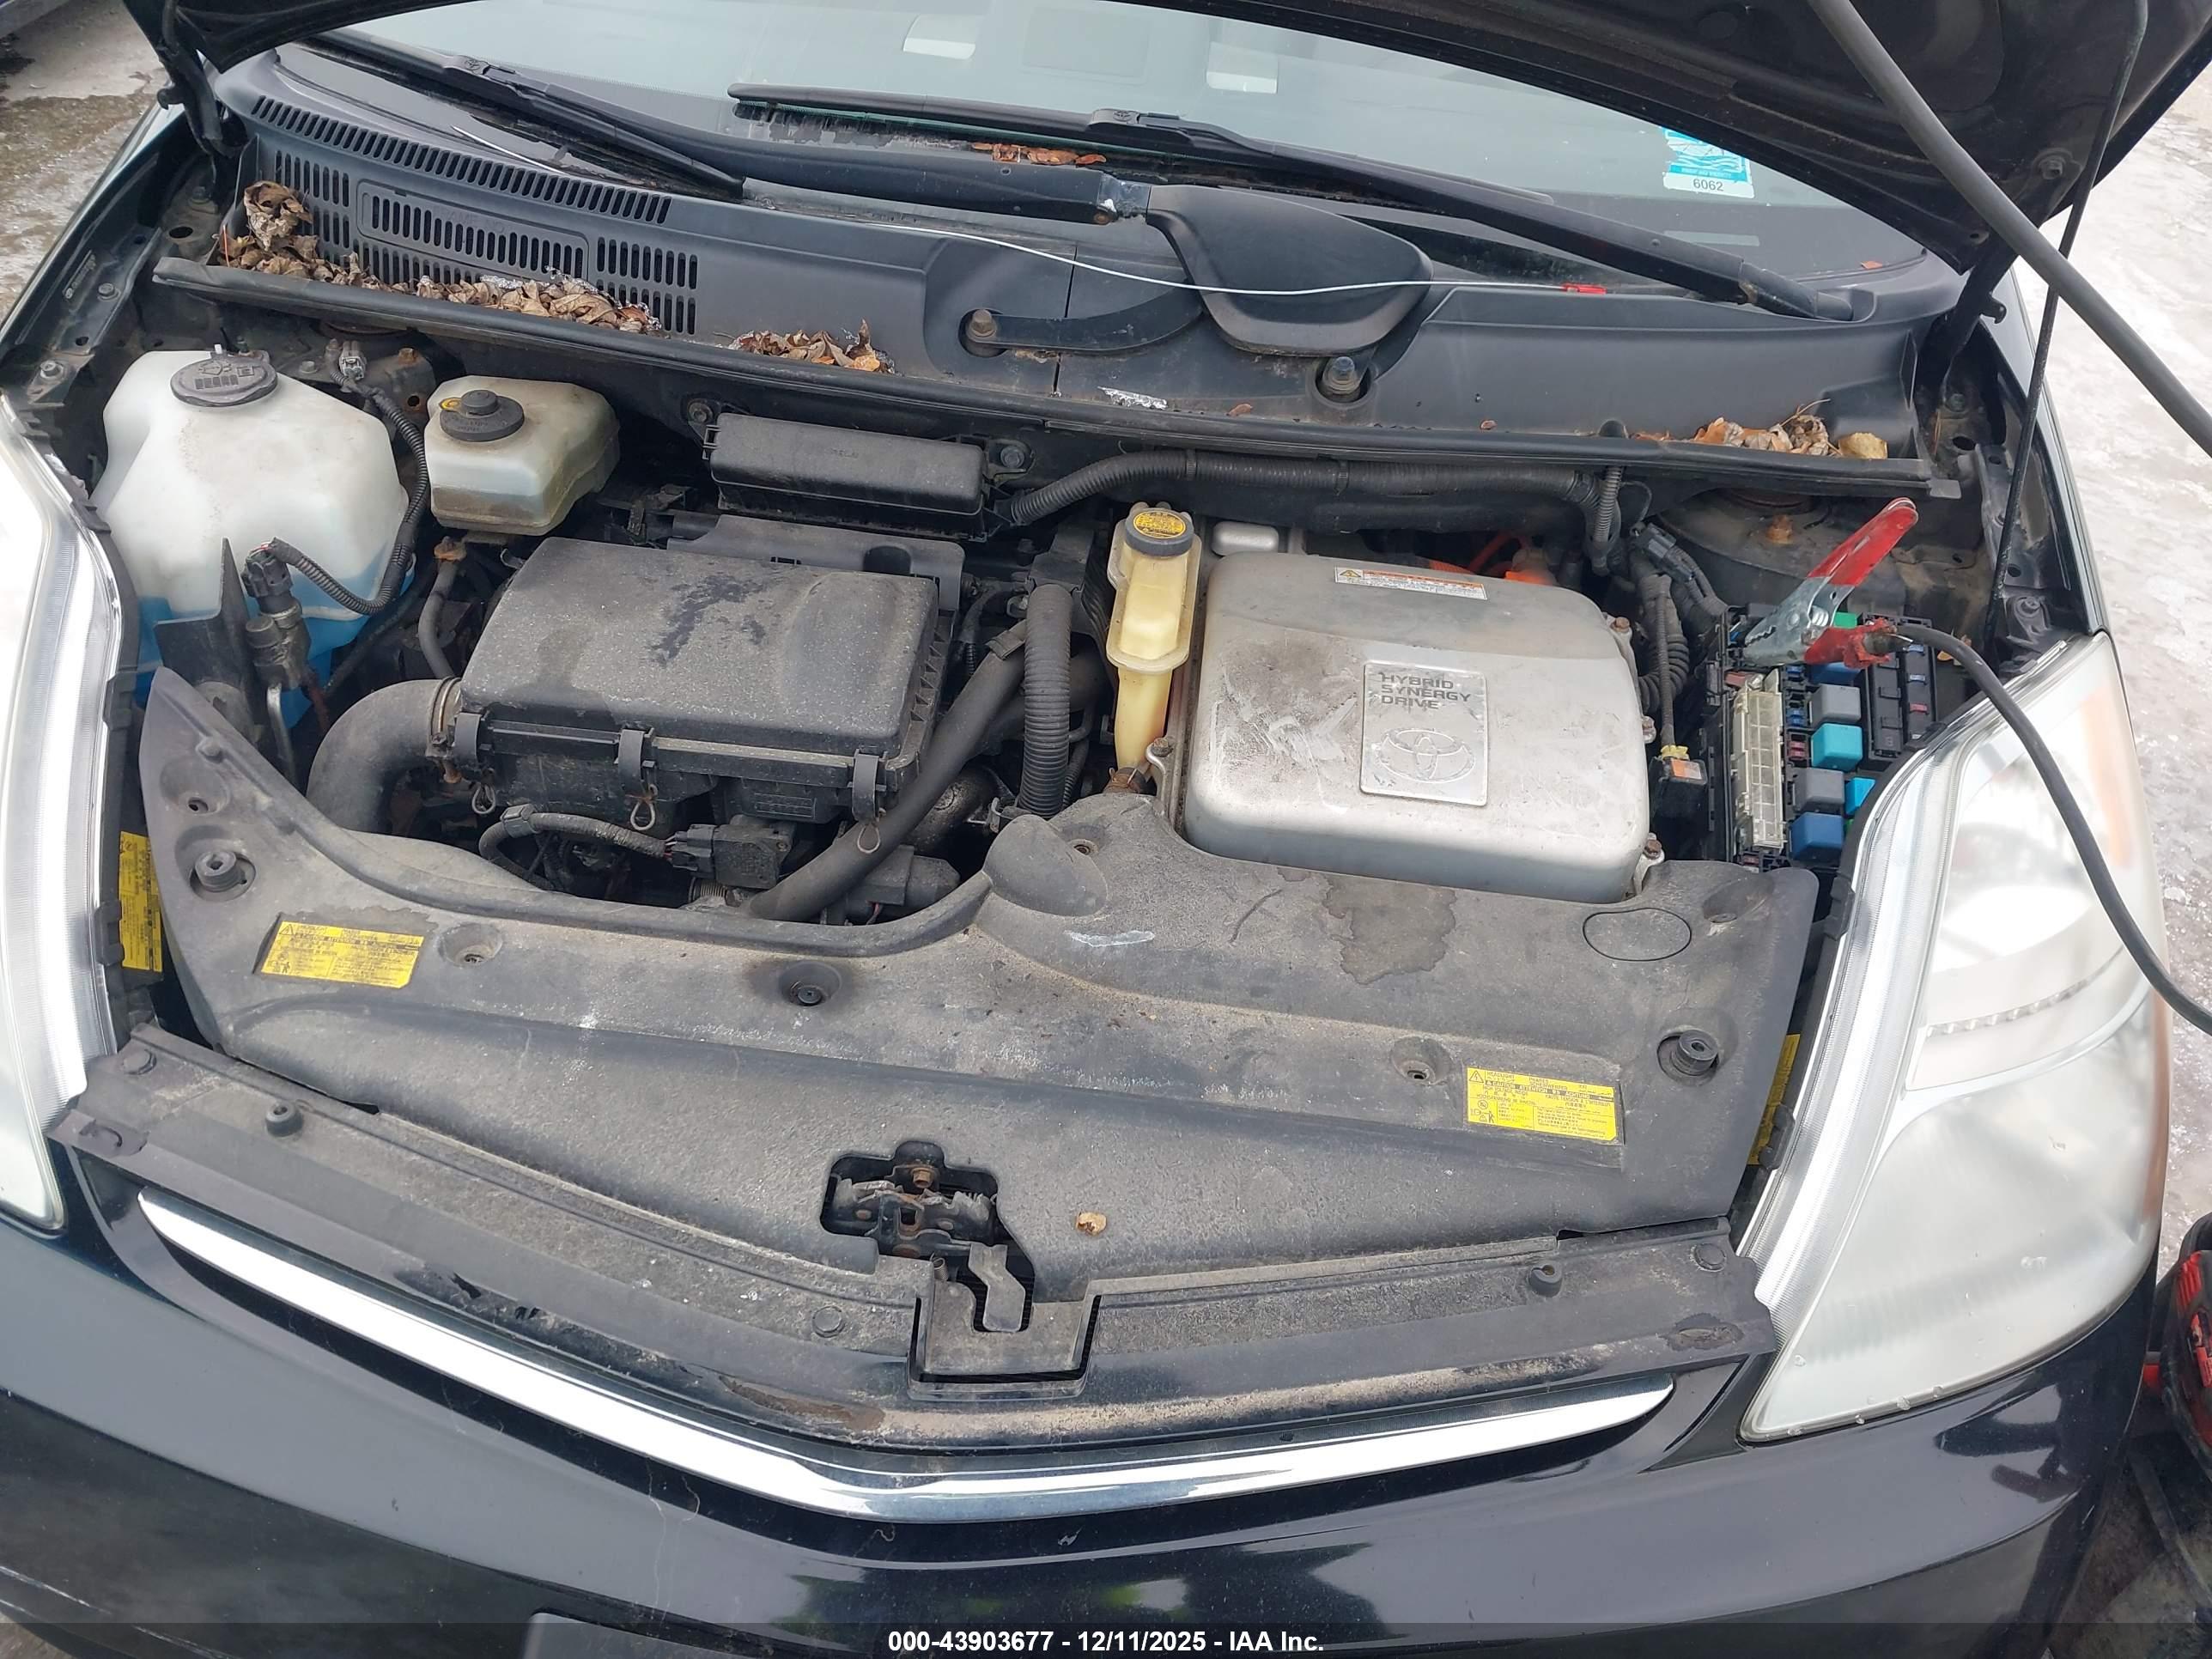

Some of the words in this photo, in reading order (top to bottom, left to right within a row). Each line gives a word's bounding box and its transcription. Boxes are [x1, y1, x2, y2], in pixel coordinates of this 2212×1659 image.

[1692, 178, 1724, 191] 6062
[1380, 673, 1454, 690] HYBRID
[1381, 684, 1471, 702] SYNERGY
[1381, 695, 1439, 710] DRIVE
[1486, 1071, 1515, 1079] HEADLIGHT
